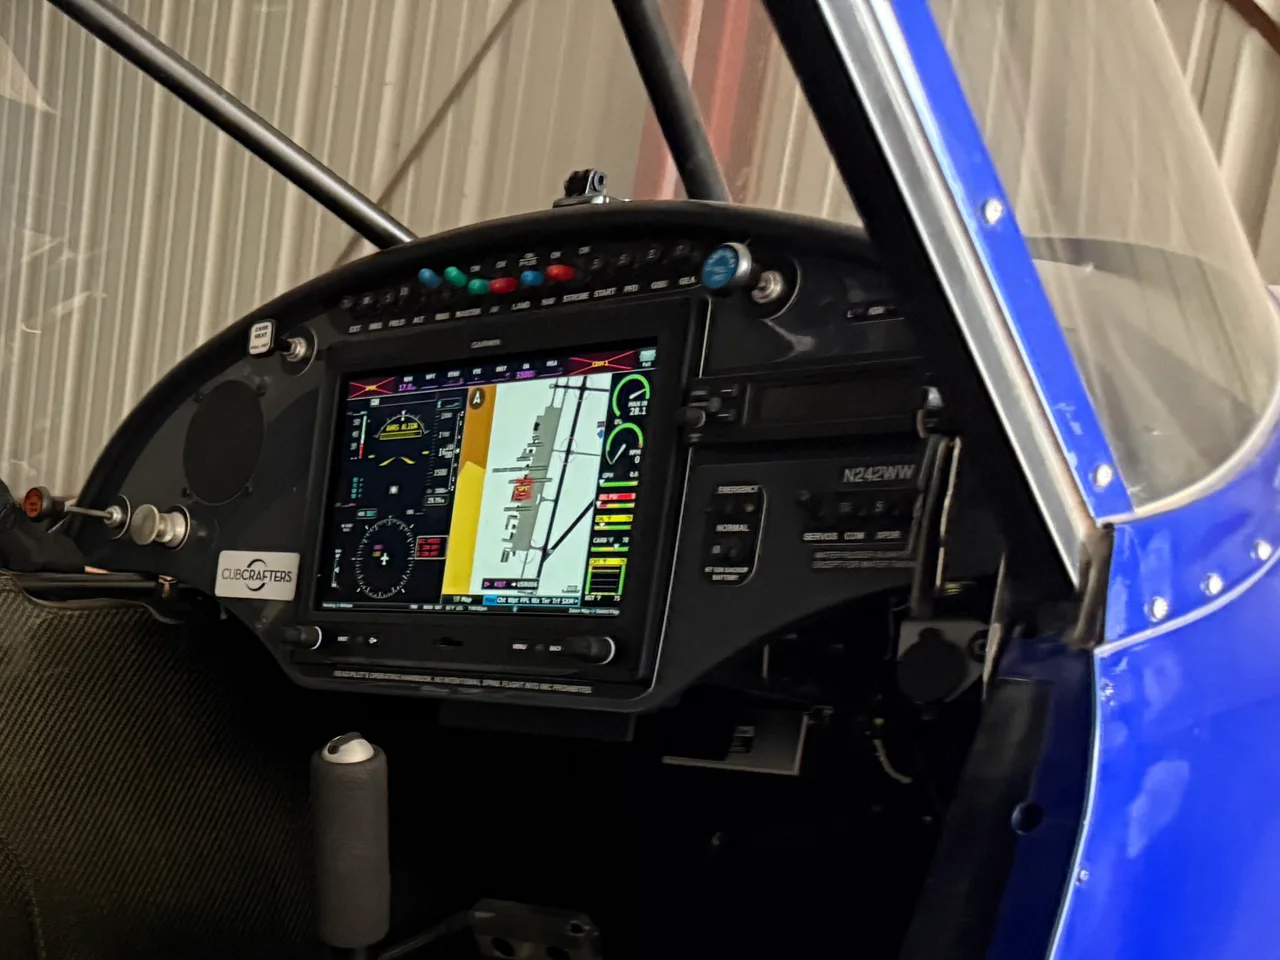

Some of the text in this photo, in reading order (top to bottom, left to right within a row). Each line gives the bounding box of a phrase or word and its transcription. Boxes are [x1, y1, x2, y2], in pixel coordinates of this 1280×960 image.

[593, 288, 618, 298] START
[471, 339, 502, 348] GARMIN
[629, 407, 646, 415] 28.1
[844, 464, 915, 483] N242WW
[716, 485, 760, 494] EMERGENCY
[716, 524, 750, 532] NORMAL
[803, 532, 838, 540] SERVOS
[222, 568, 292, 583] CUBCRAFTERS
